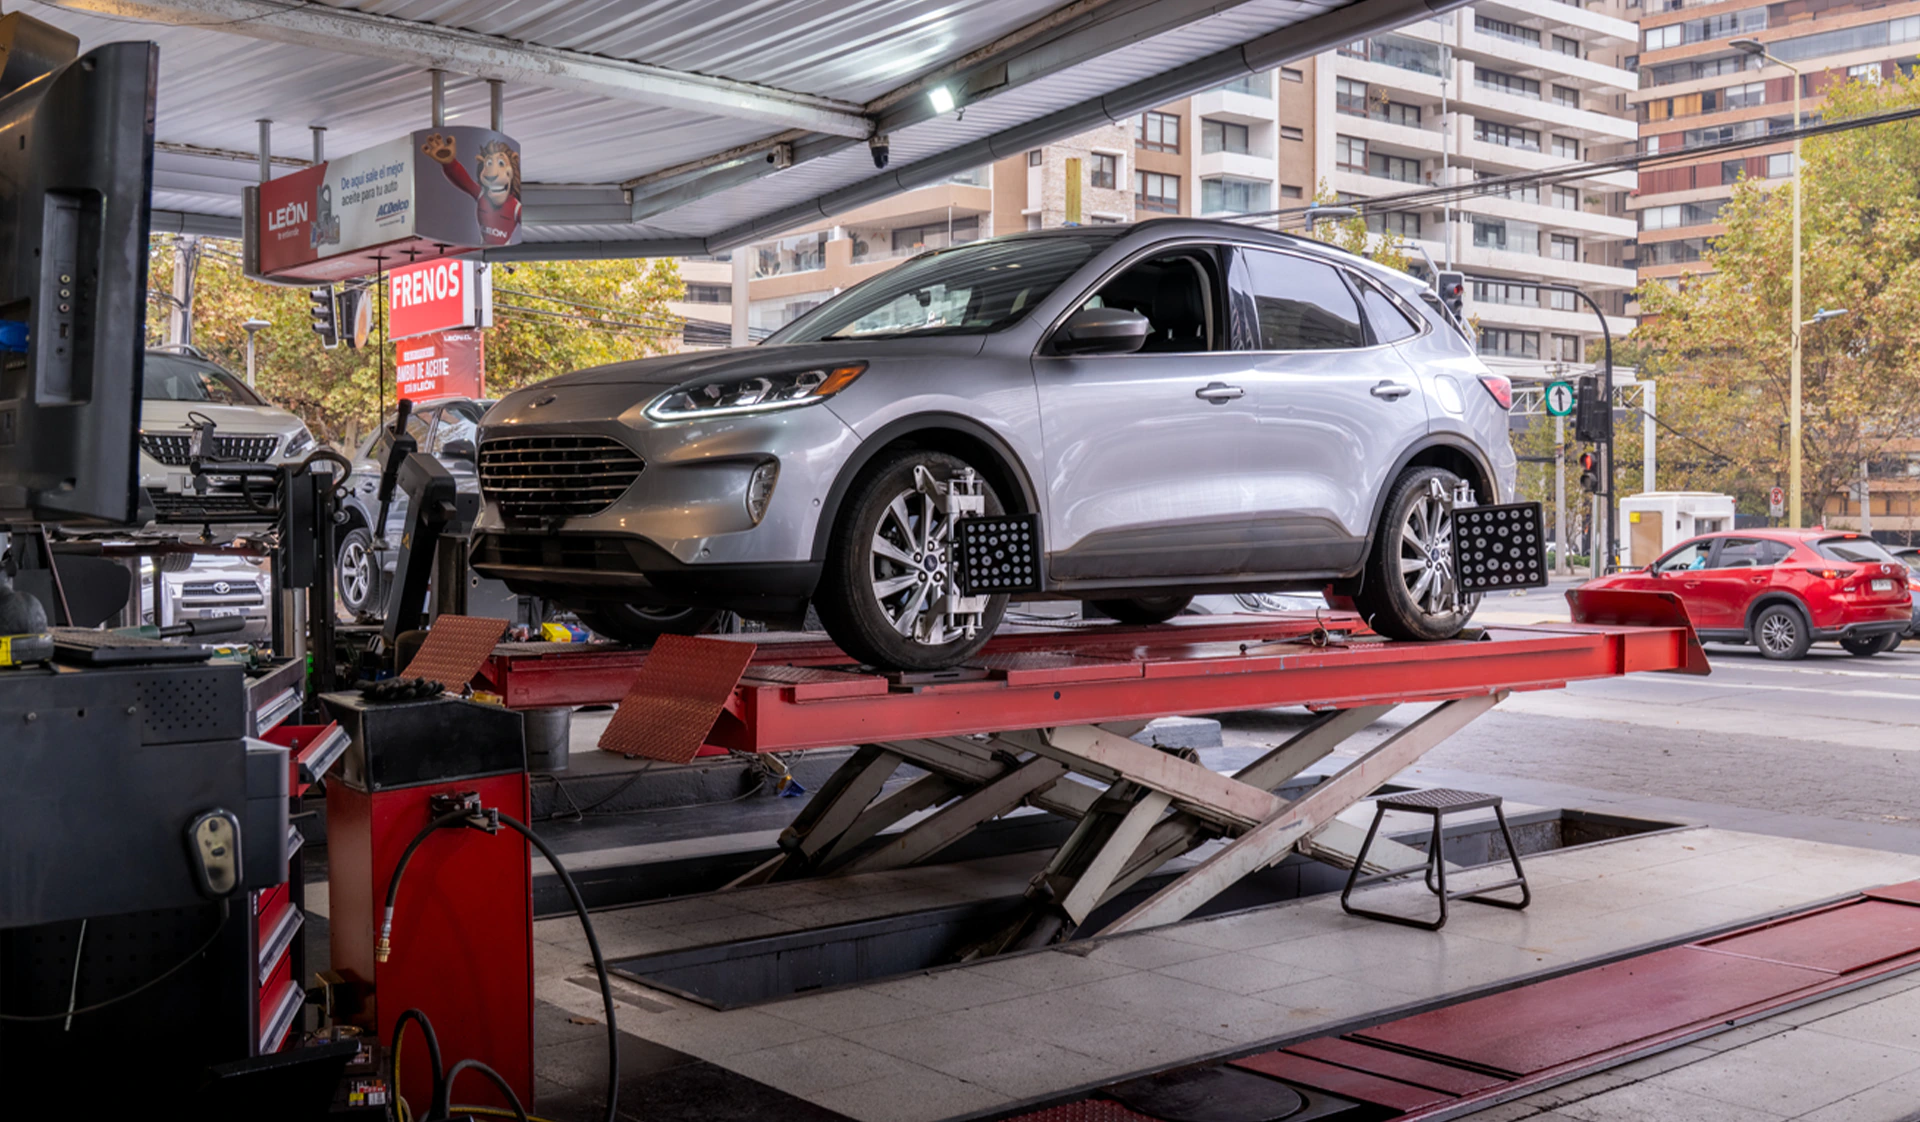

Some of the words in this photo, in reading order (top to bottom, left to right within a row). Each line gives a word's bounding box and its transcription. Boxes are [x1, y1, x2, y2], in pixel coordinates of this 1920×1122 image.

[341, 177, 350, 190] De
[366, 167, 379, 183] sale
[379, 164, 386, 179] el
[386, 160, 404, 178] mejor
[341, 190, 361, 206] aceite
[361, 187, 376, 204] para
[376, 184, 383, 197] tu
[384, 180, 399, 194] auto
[376, 199, 409, 217] ACDelco
[392, 262, 460, 310] FRENOS
[426, 357, 449, 378] ACEITE
